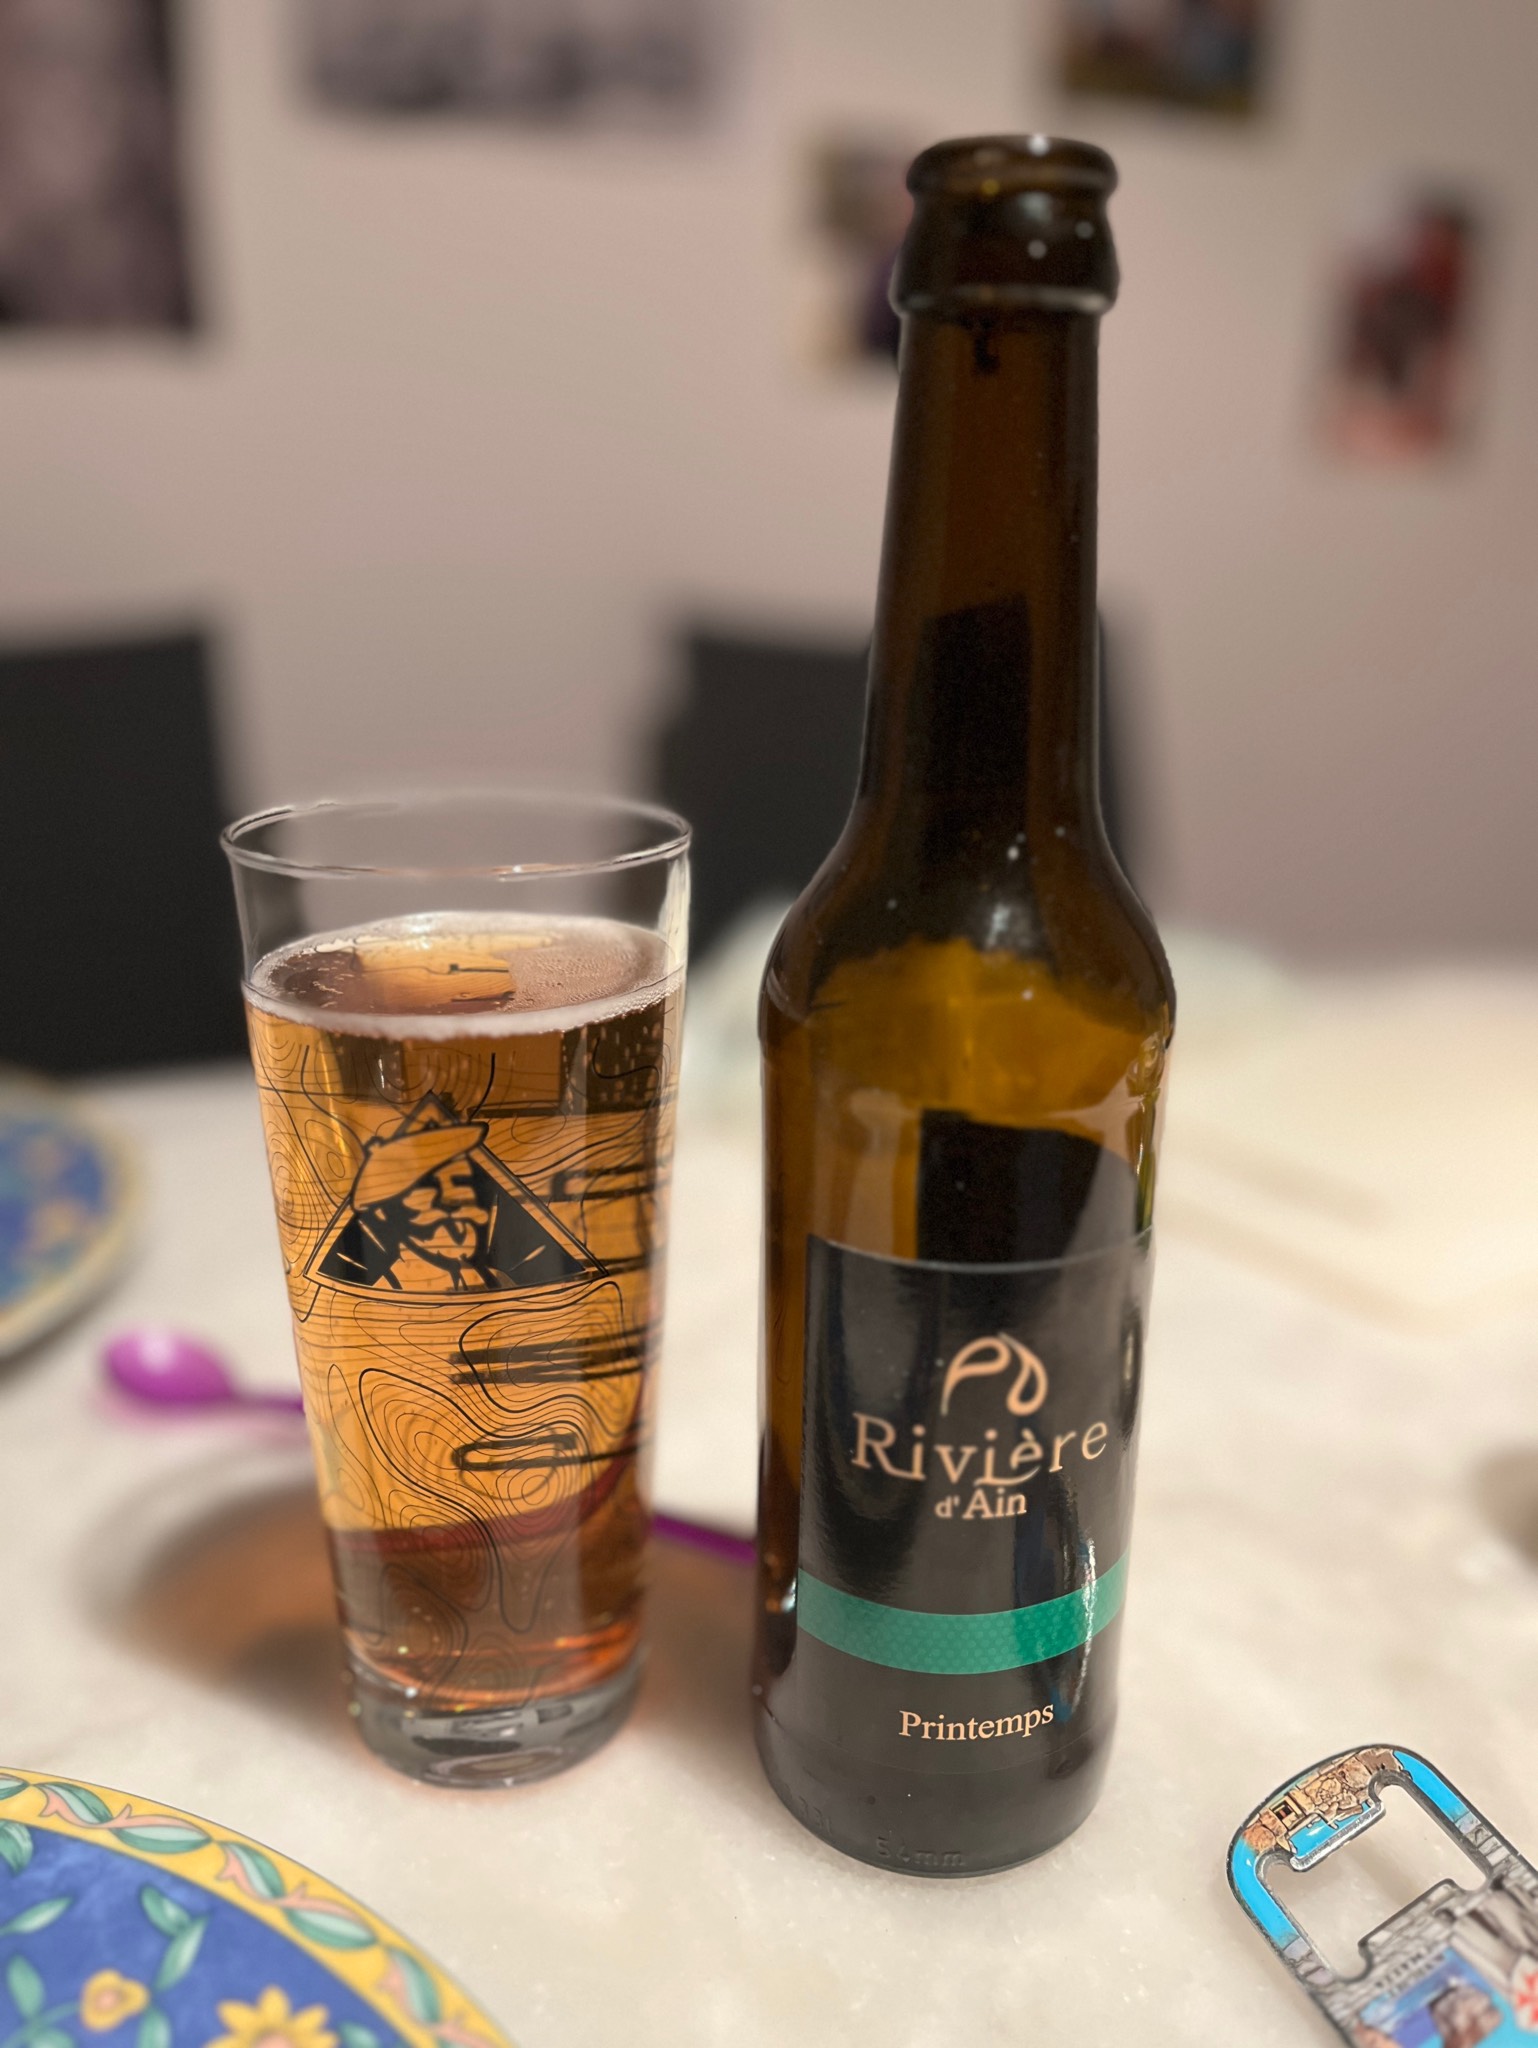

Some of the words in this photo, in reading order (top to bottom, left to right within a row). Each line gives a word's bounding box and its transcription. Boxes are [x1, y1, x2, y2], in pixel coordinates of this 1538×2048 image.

[851, 1411, 1109, 1486] Rivière
[934, 1487, 1028, 1519] d'Ain
[898, 1704, 1055, 1741] Printemps
